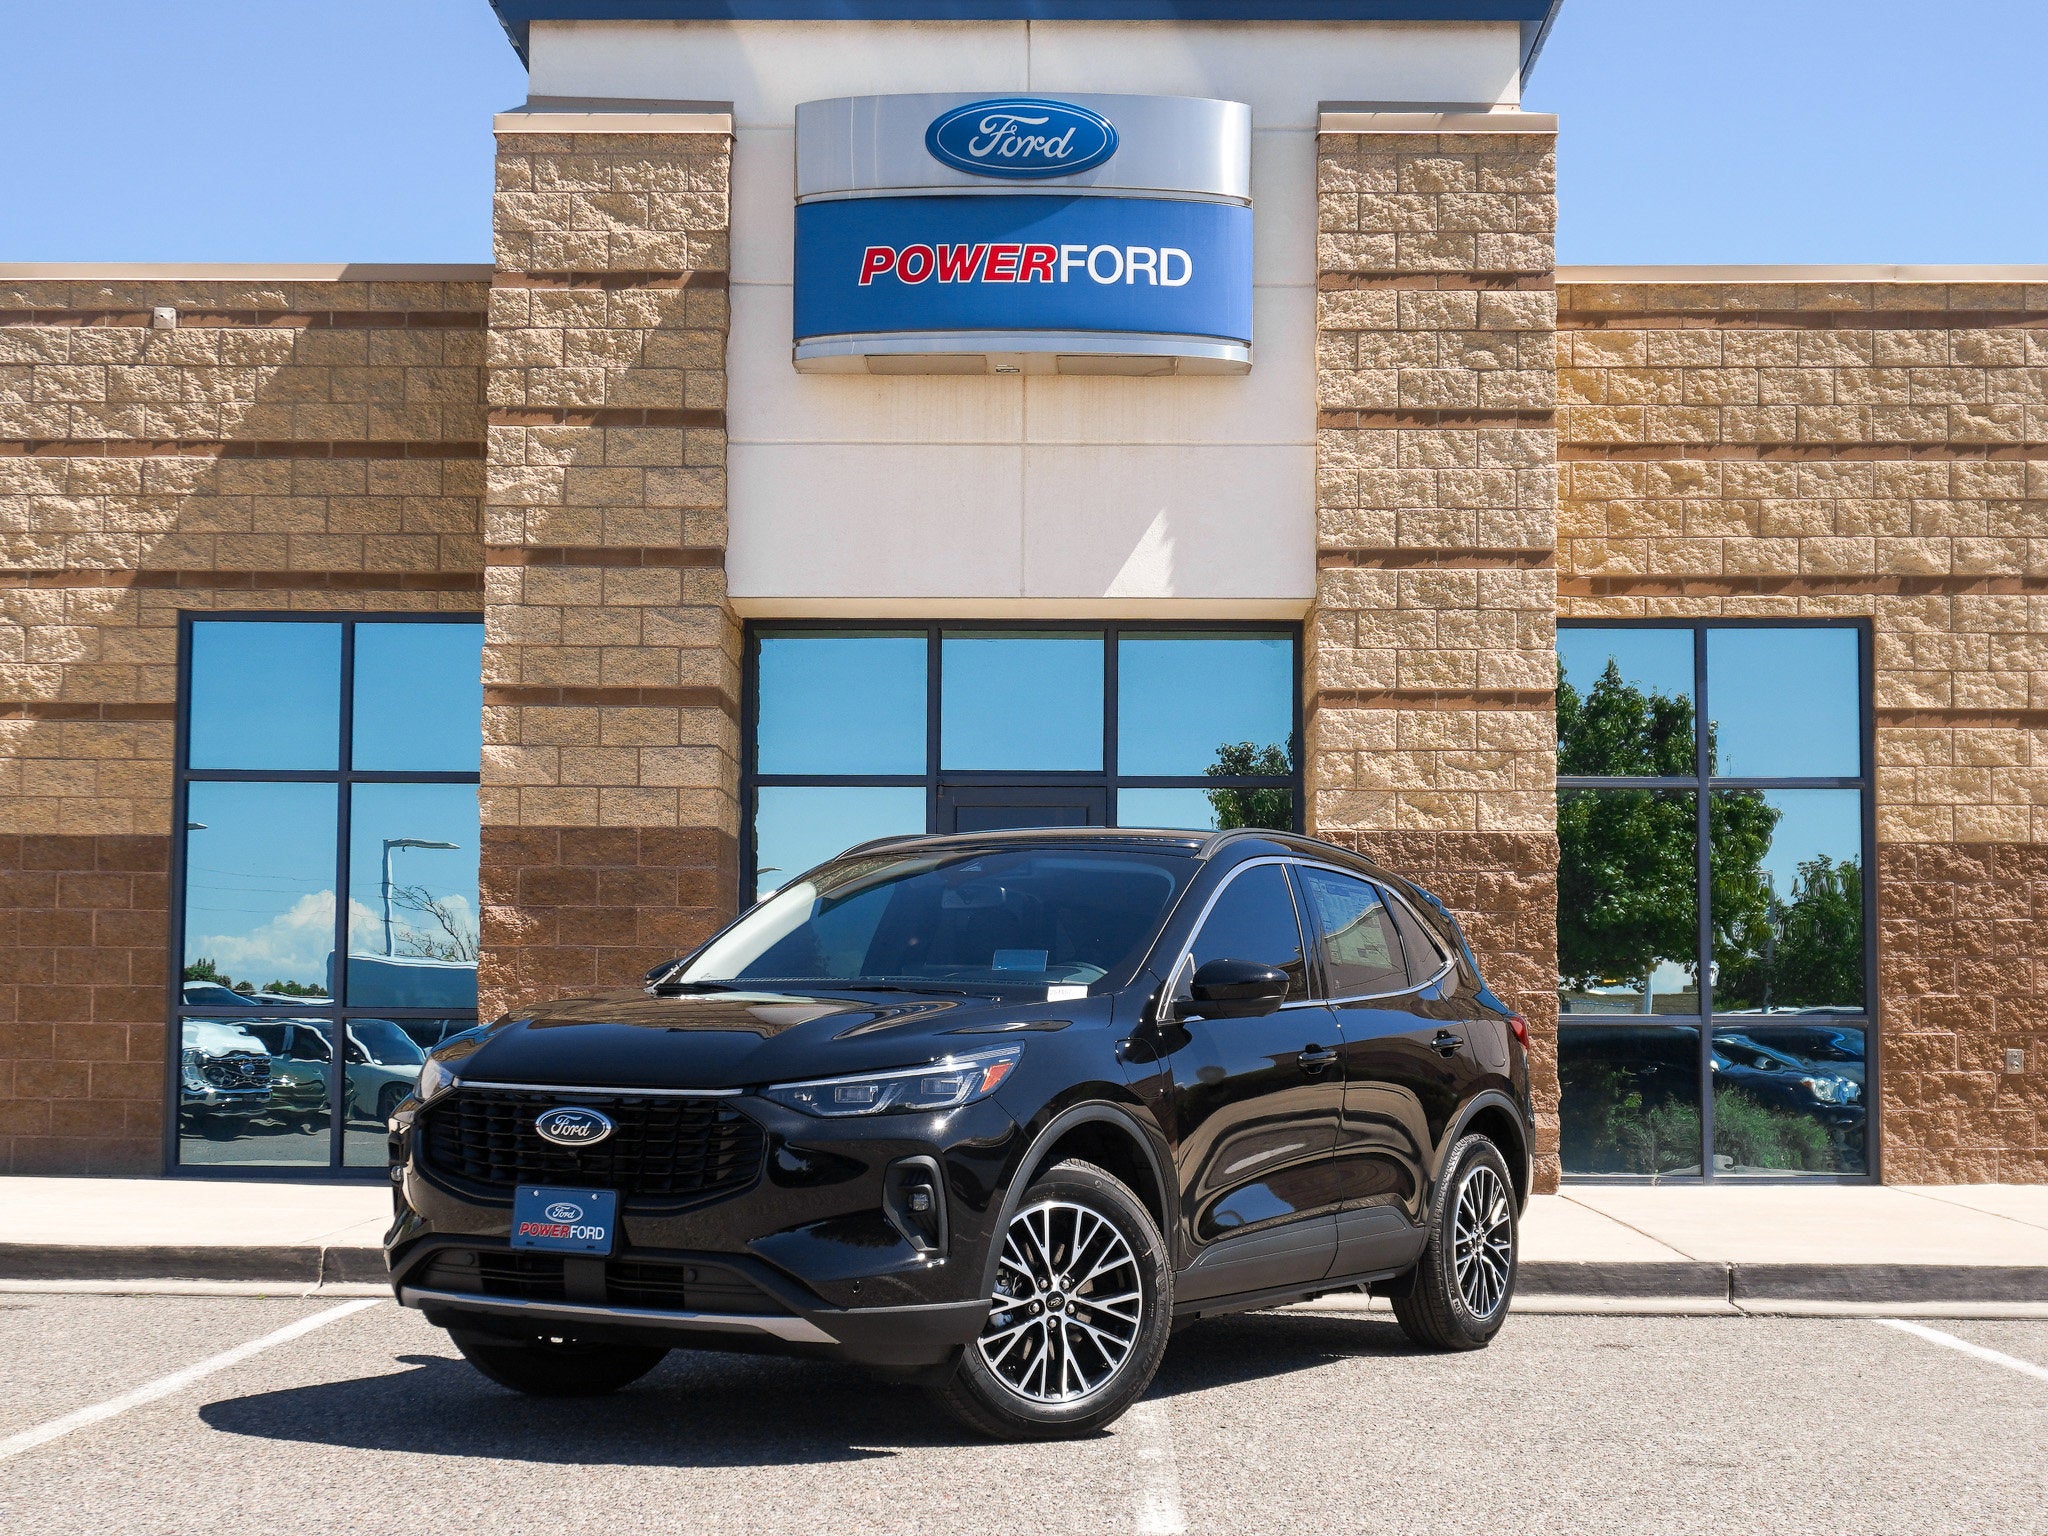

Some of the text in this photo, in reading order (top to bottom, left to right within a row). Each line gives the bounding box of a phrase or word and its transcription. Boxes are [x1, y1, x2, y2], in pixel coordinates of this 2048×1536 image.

[968, 114, 1077, 159] Ford
[550, 1114, 590, 1136] Ford
[552, 1206, 575, 1218] Ford
